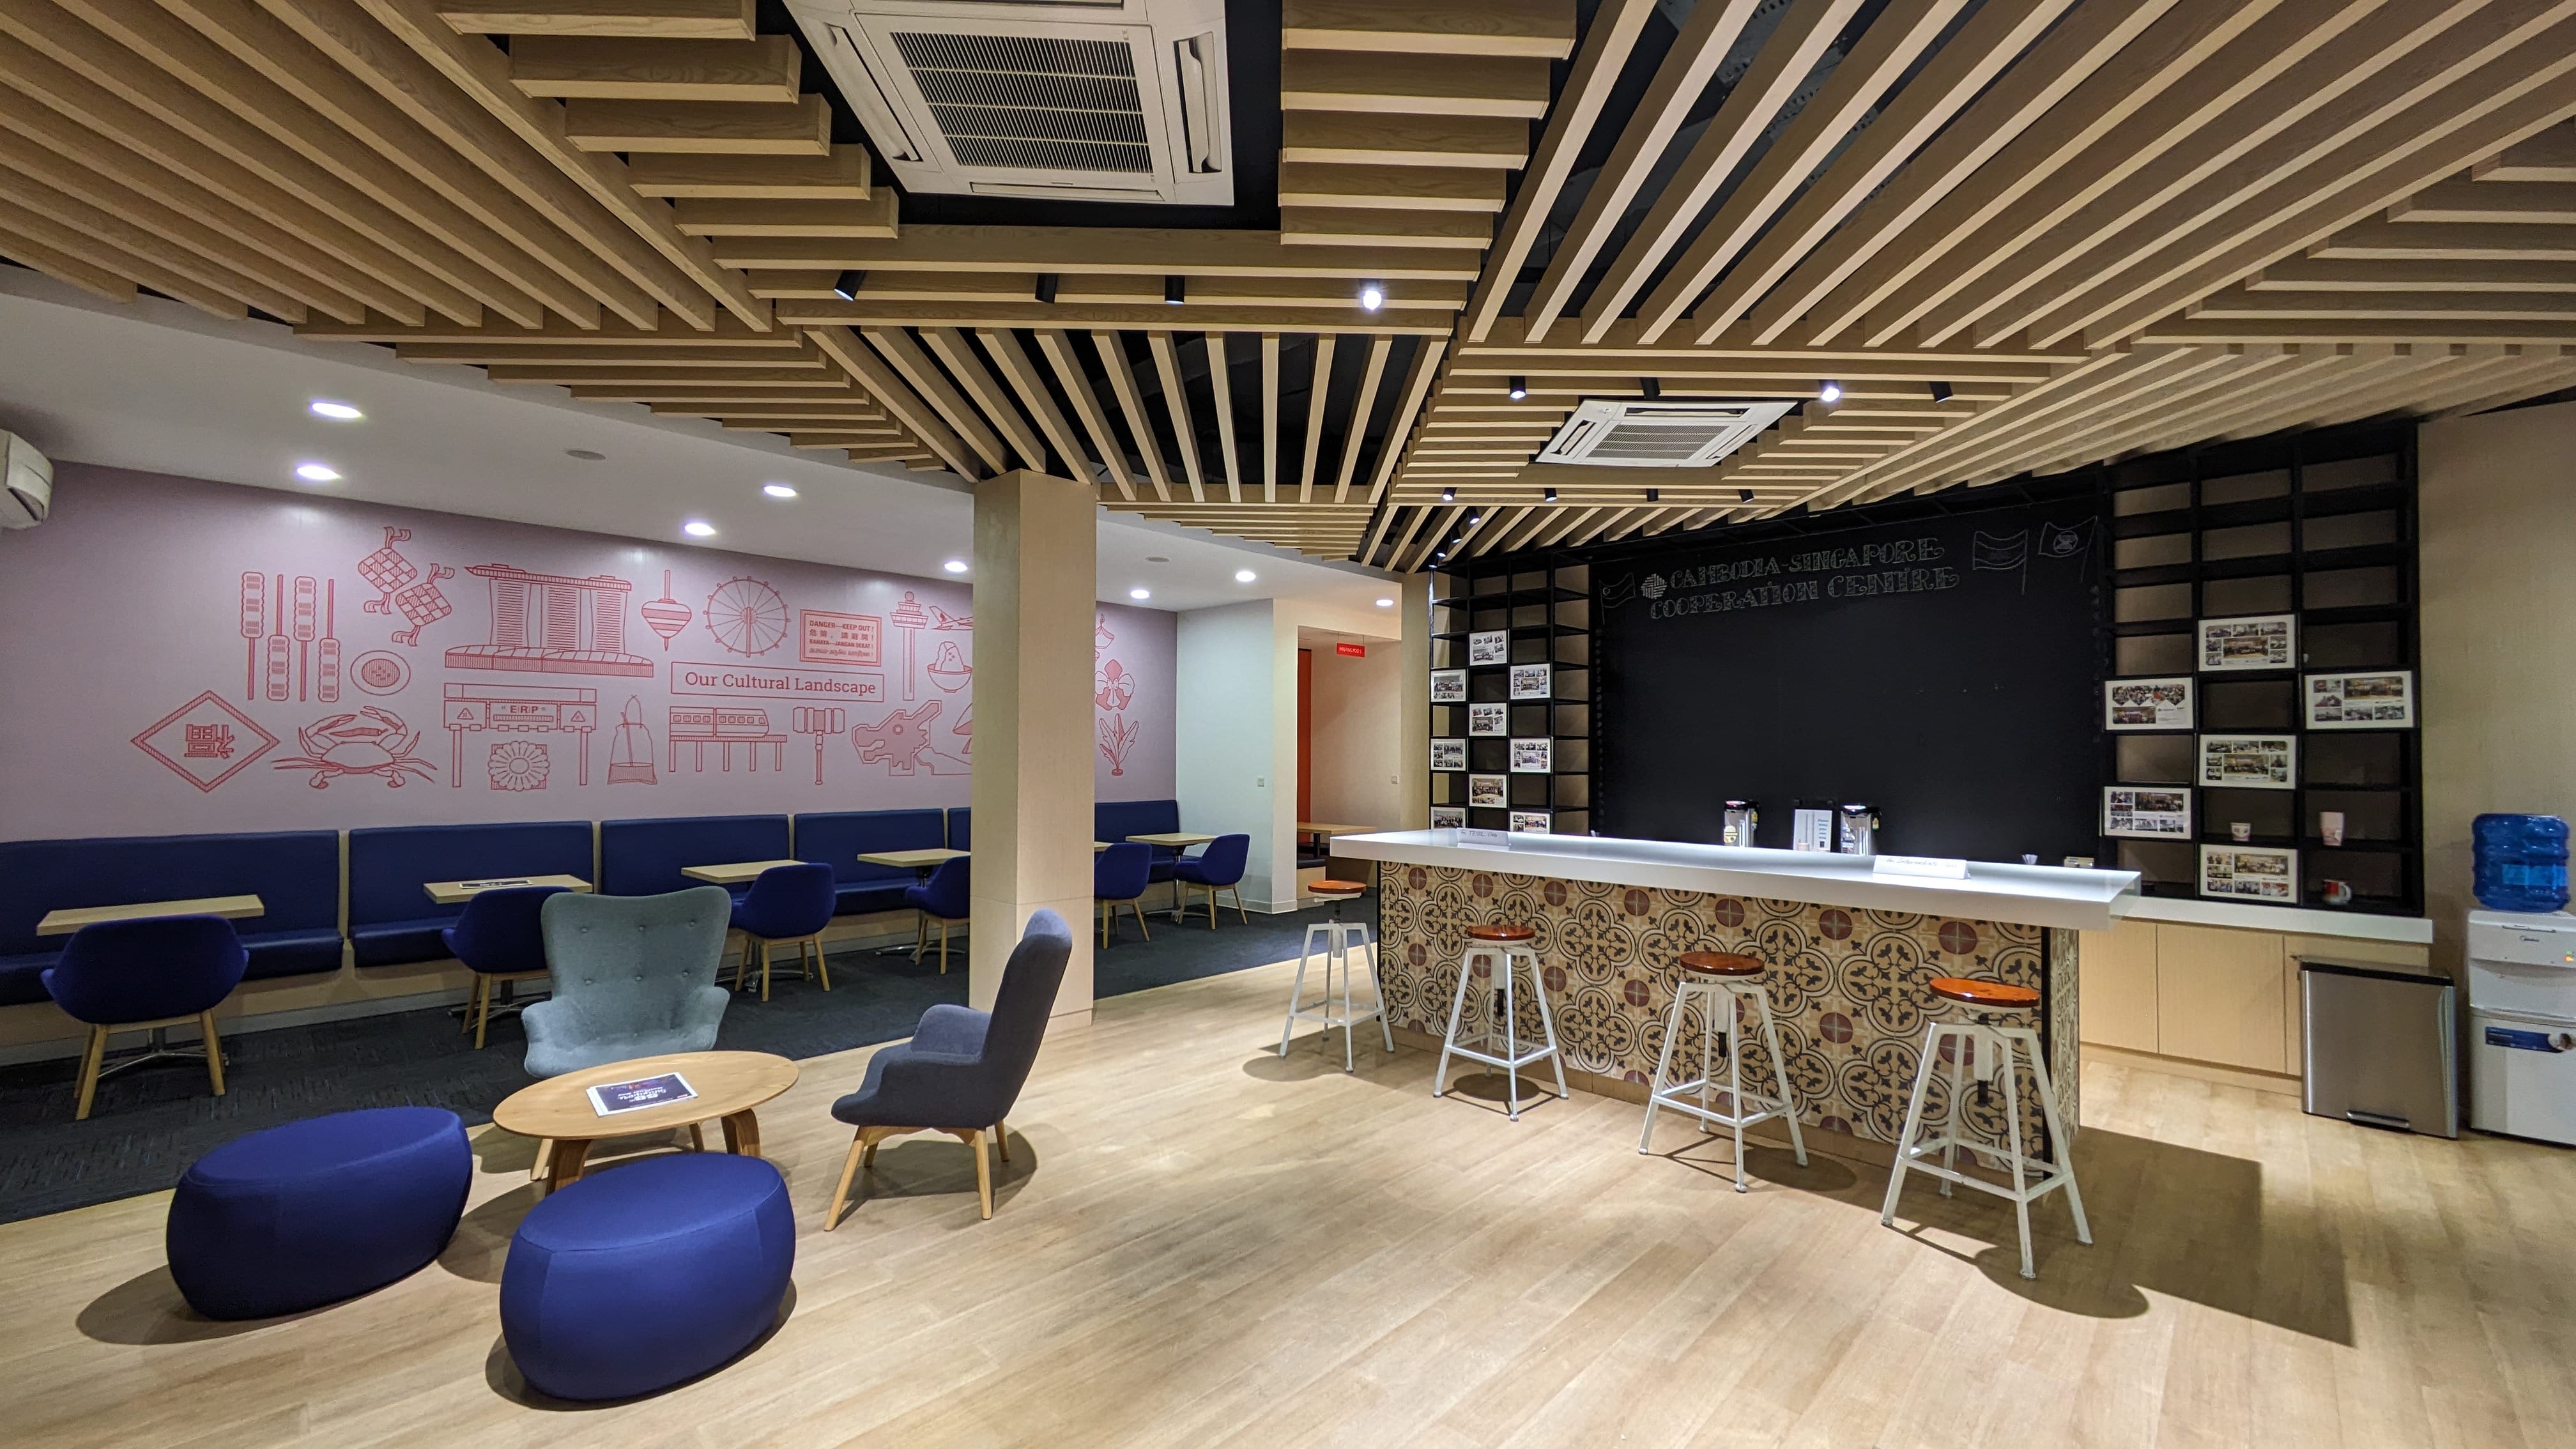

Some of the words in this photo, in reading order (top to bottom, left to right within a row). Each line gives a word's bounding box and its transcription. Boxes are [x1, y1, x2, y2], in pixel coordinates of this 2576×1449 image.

[1650, 581, 1820, 620] COOPERATION
[1827, 566, 1960, 598] CENTRE
[685, 671, 717, 687] Our
[723, 674, 790, 690] Cultural
[794, 677, 876, 696] Landscape
